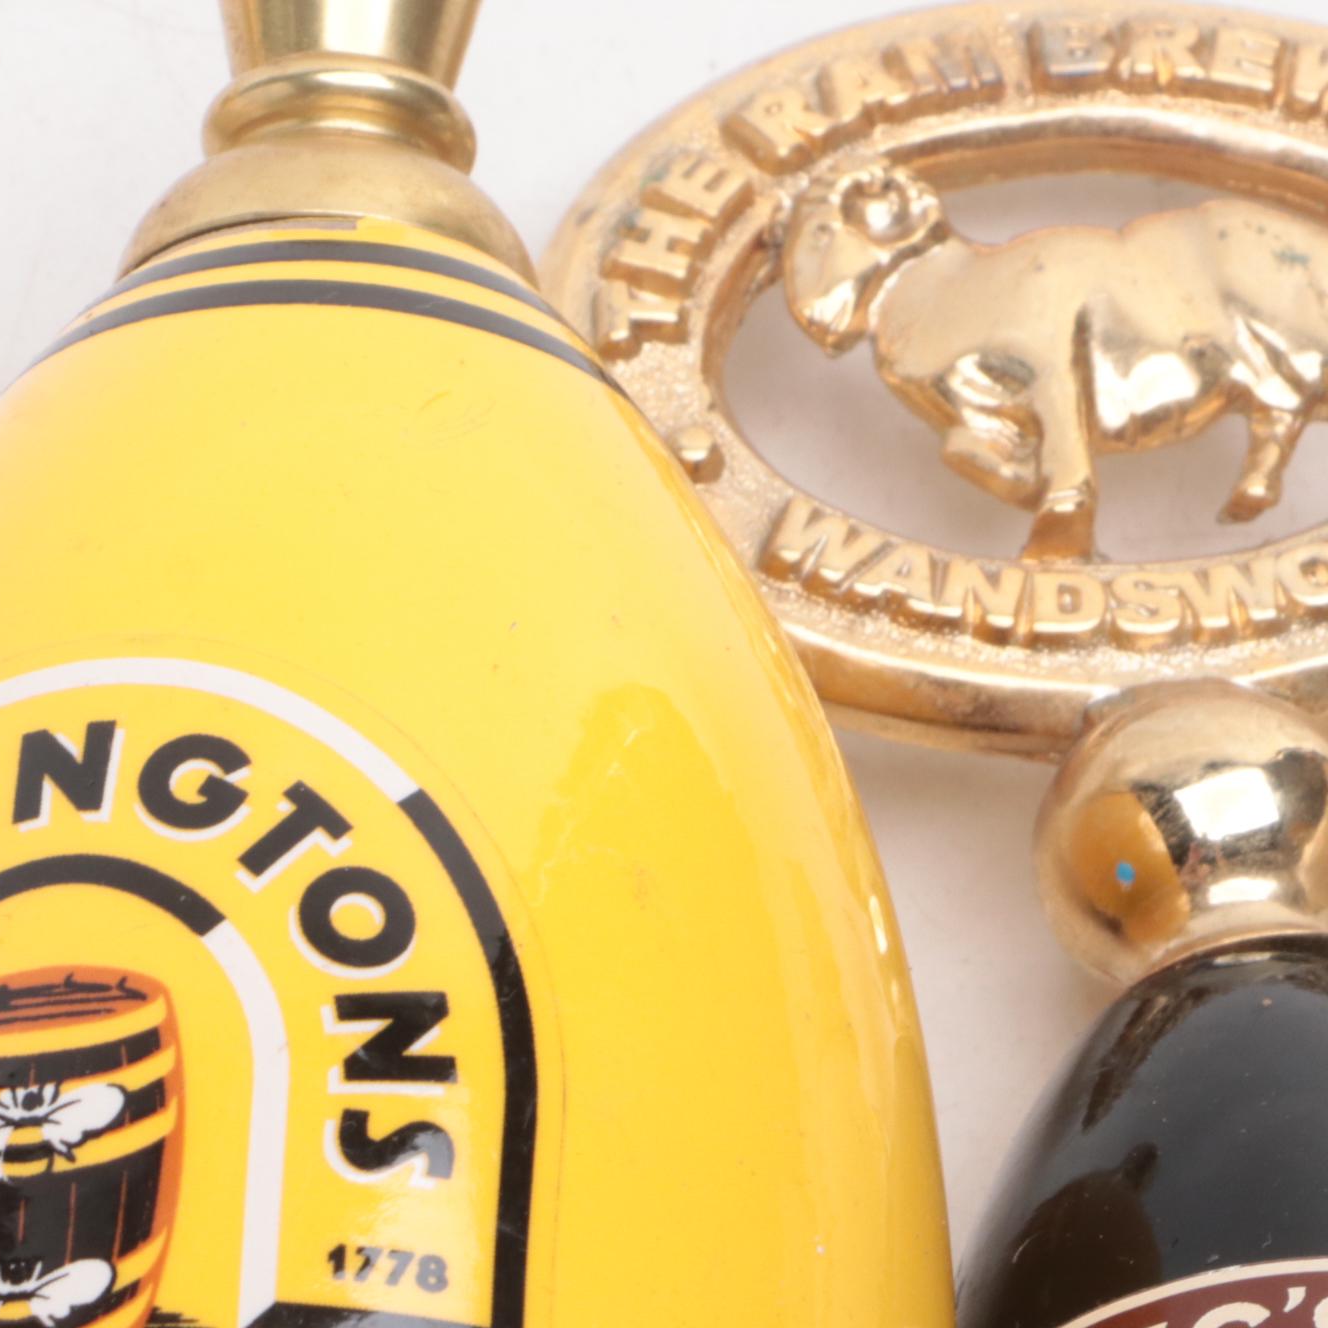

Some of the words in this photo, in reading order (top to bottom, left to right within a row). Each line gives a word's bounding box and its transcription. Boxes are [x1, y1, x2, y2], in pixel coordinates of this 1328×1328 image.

[597, 150, 754, 360] THE
[719, 33, 1006, 176] RAM
[326, 1243, 449, 1294] 1778
